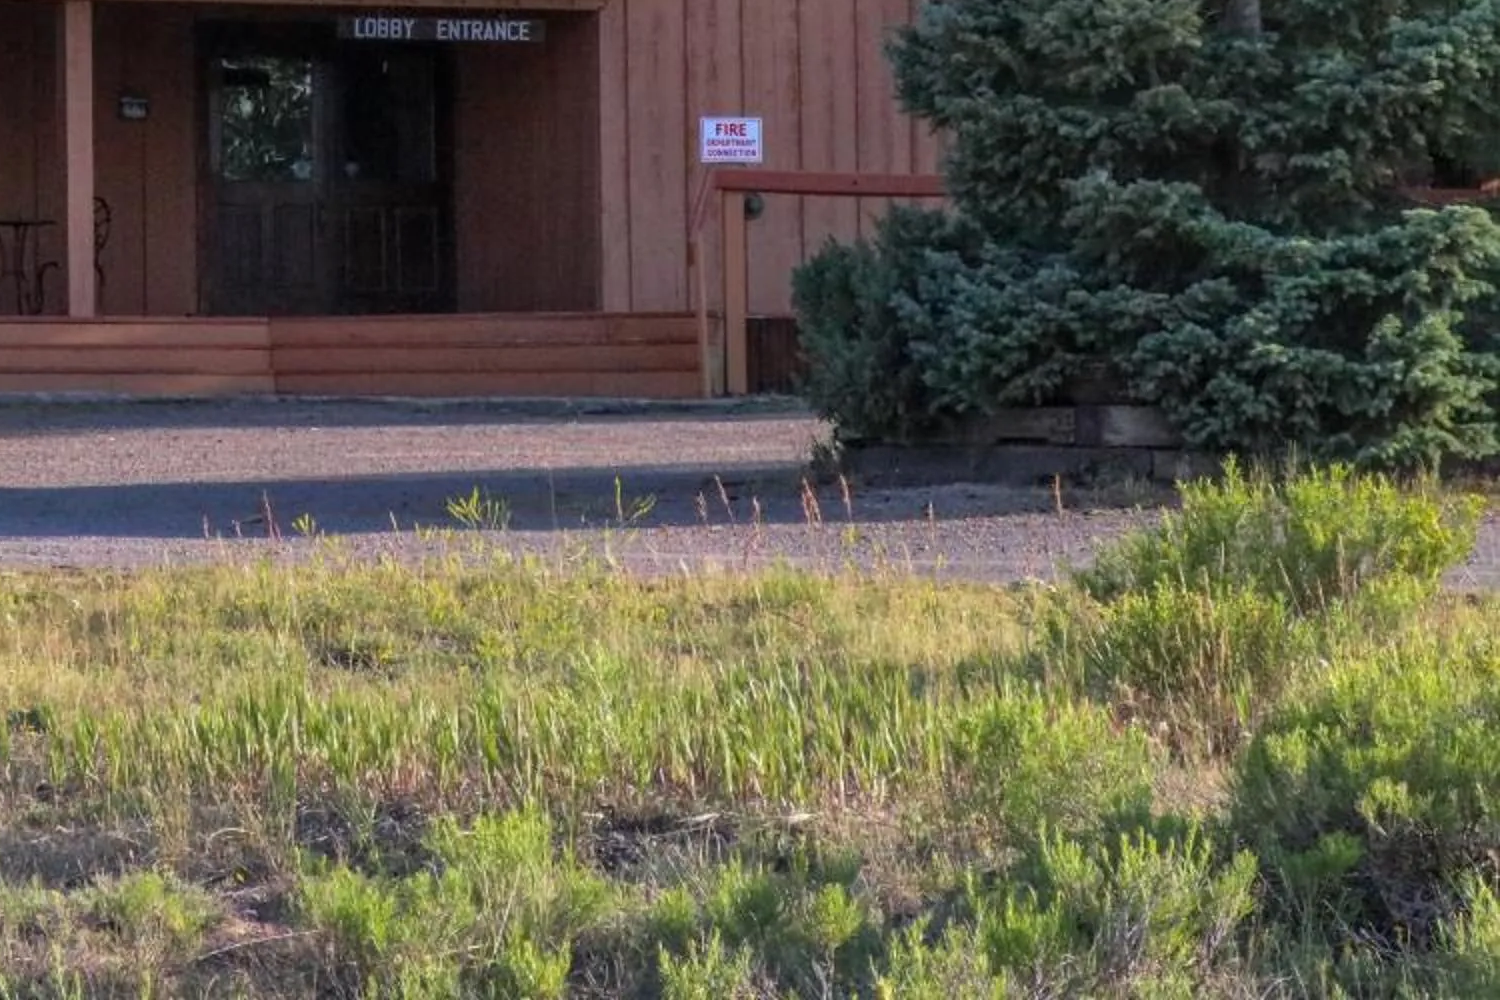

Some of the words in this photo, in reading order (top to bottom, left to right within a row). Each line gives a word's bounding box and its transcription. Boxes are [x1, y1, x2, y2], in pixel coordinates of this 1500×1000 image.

[355, 18, 414, 38] LOBBY
[436, 19, 530, 40] ENTRANCE
[715, 123, 747, 136] FIRE
